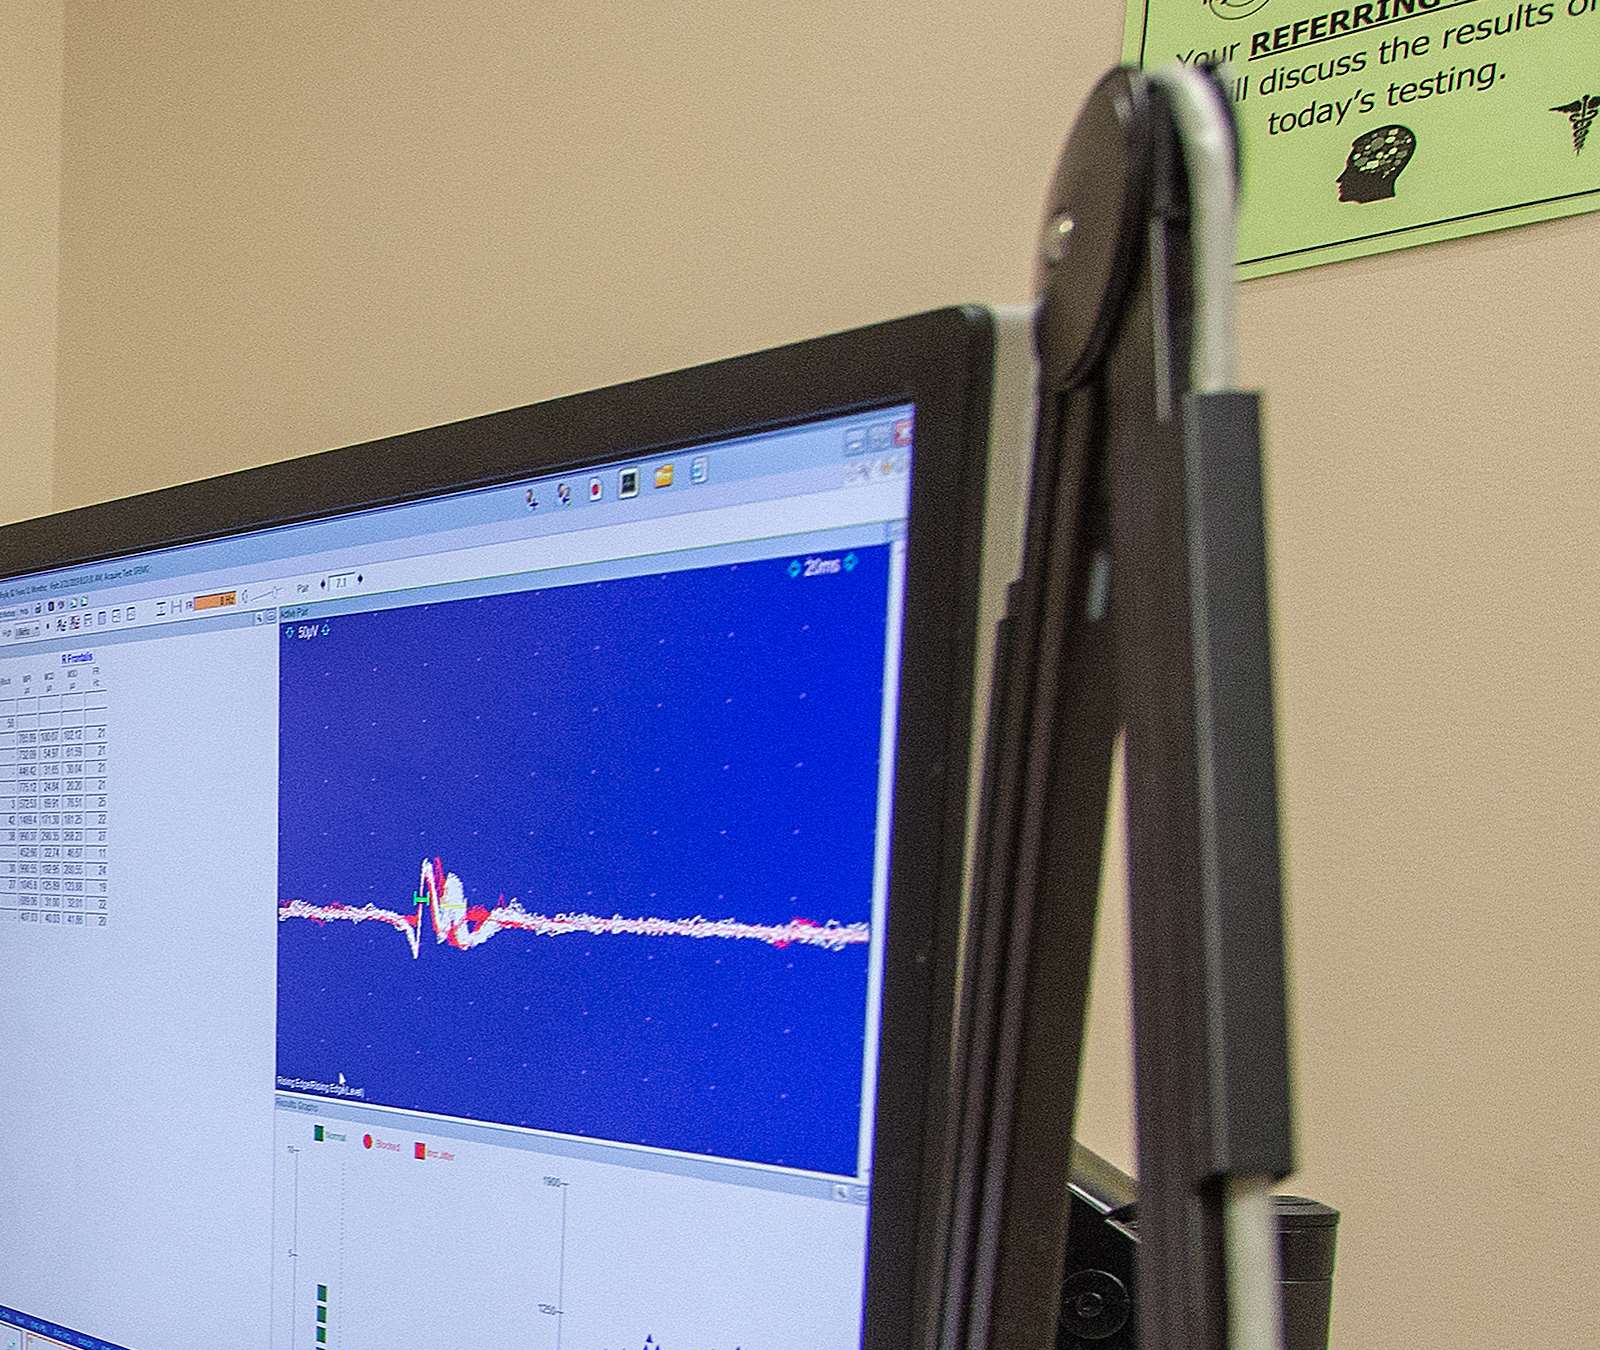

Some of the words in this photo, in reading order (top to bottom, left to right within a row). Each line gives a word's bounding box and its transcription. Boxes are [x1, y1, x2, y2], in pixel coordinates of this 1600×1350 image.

[1176, 40, 1240, 67] Your
[1259, 51, 1367, 96] discuss
[1378, 33, 1430, 65] the
[1442, 3, 1554, 49] results
[1267, 89, 1375, 136] today's
[1387, 62, 1506, 107] testing.
